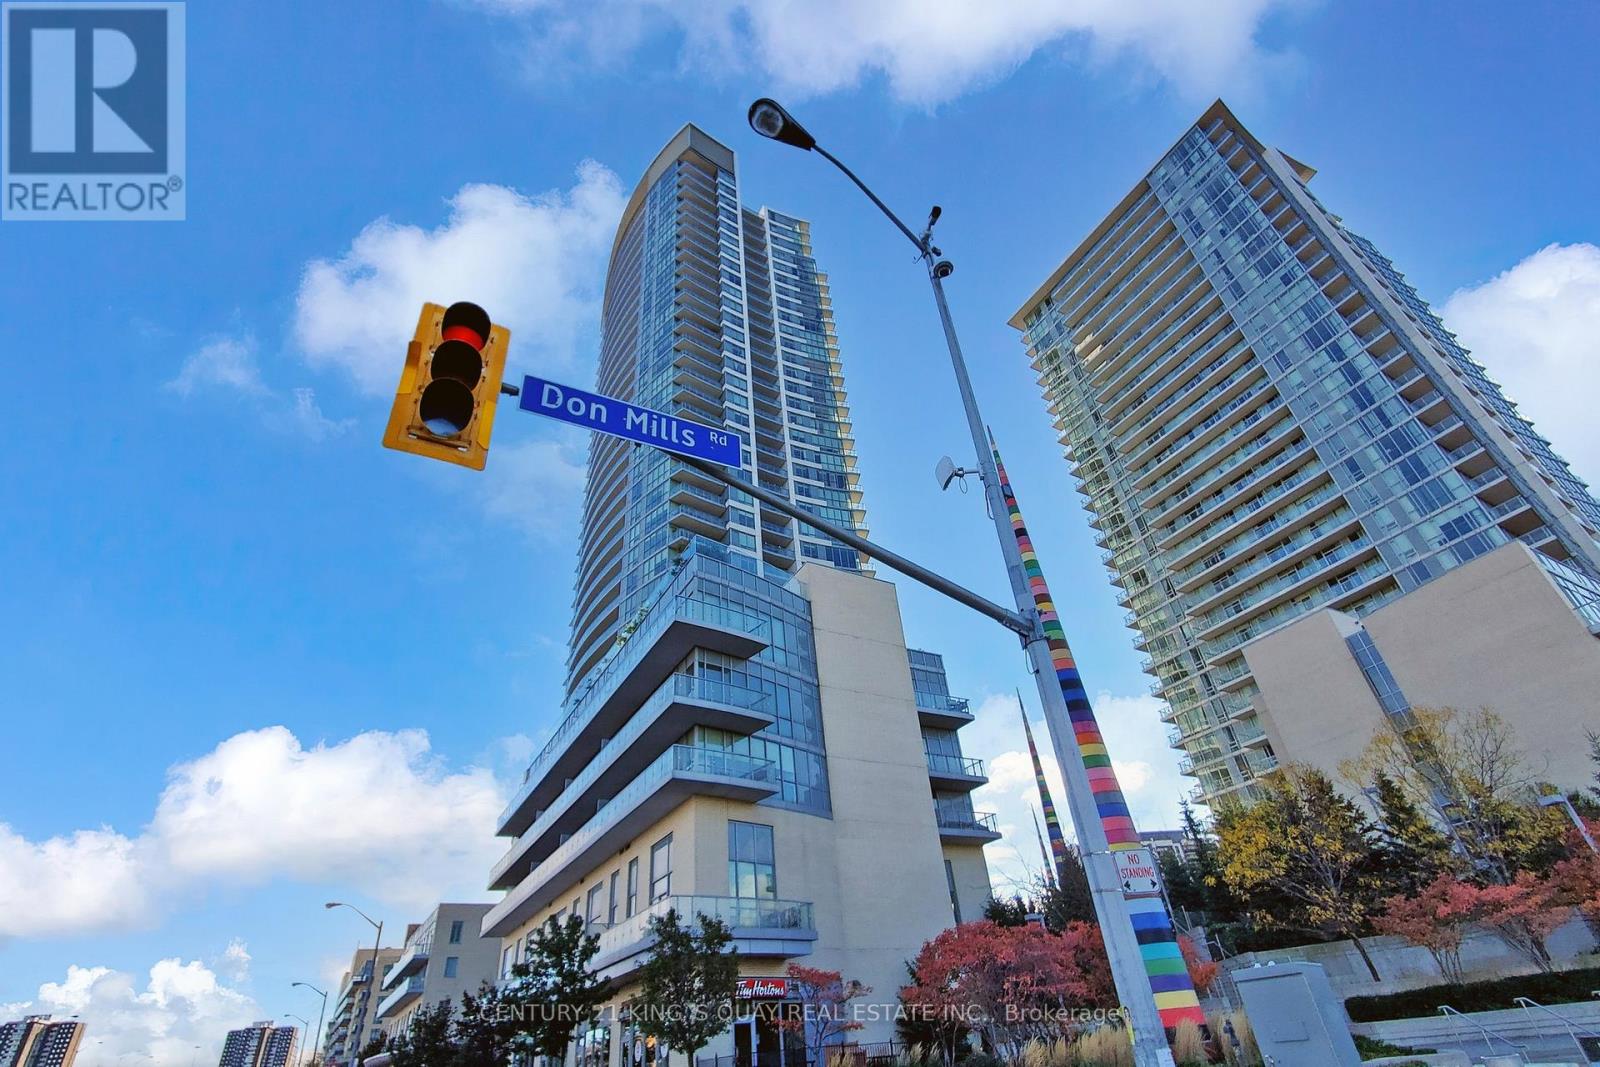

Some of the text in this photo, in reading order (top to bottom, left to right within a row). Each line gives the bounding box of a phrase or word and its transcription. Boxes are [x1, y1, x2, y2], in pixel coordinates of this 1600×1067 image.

[541, 383, 727, 447] Don Mills Rd
[1127, 853, 1140, 864] NO
[1121, 867, 1154, 879] STANDING
[752, 980, 784, 997] Hortons
